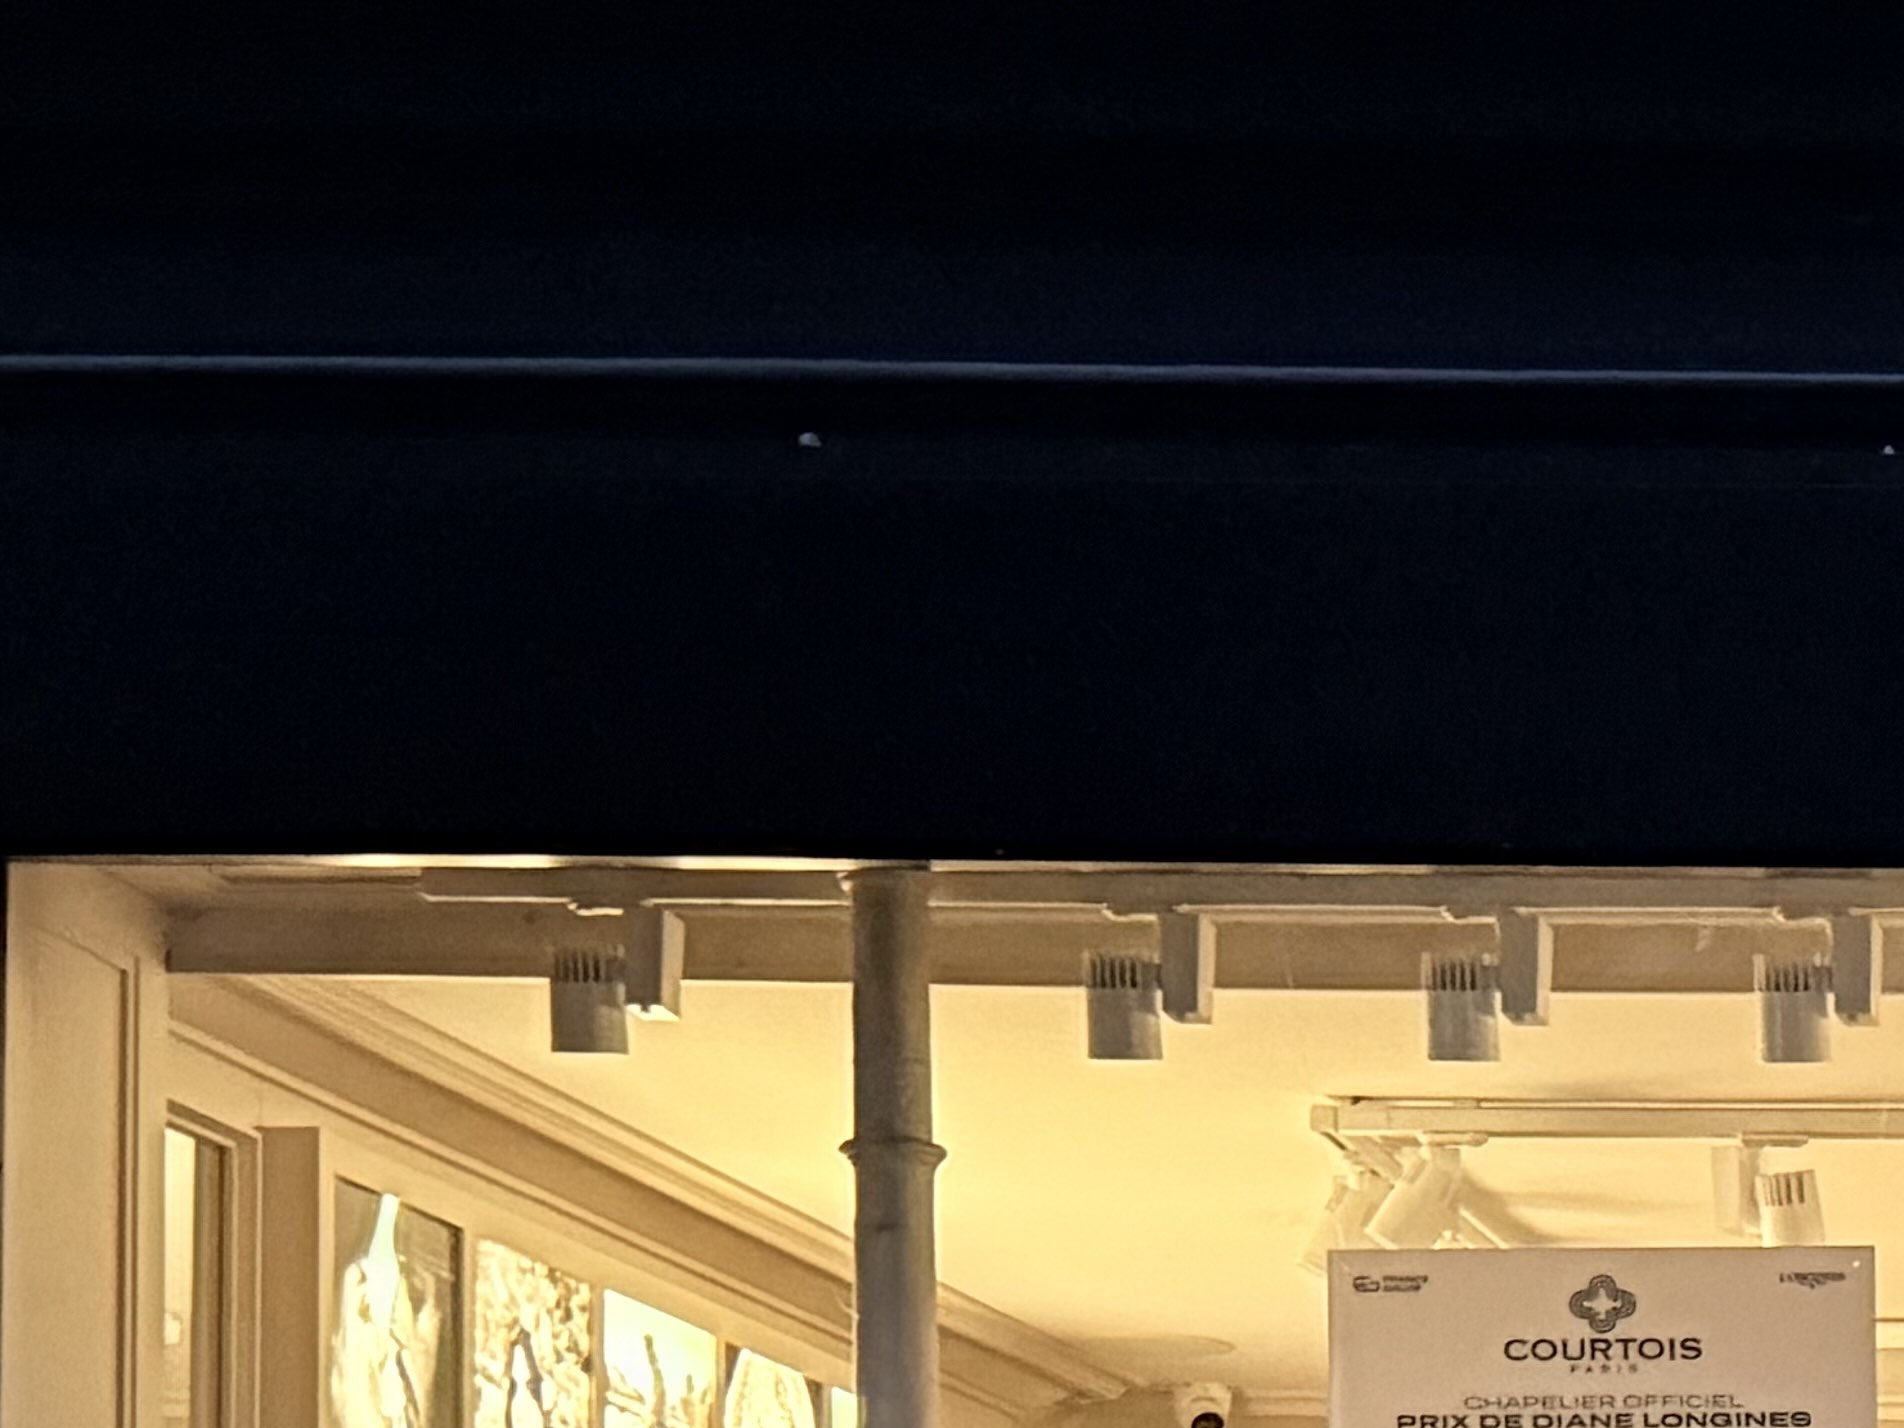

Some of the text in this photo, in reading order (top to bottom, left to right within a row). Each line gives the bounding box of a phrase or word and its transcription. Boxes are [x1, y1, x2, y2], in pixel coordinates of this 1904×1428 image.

[1503, 1337, 1703, 1361] COURTOIS
[1463, 1393, 1745, 1411] CHAPELIER OFFICIEL
[1643, 1411, 1813, 1428] LONGINES
